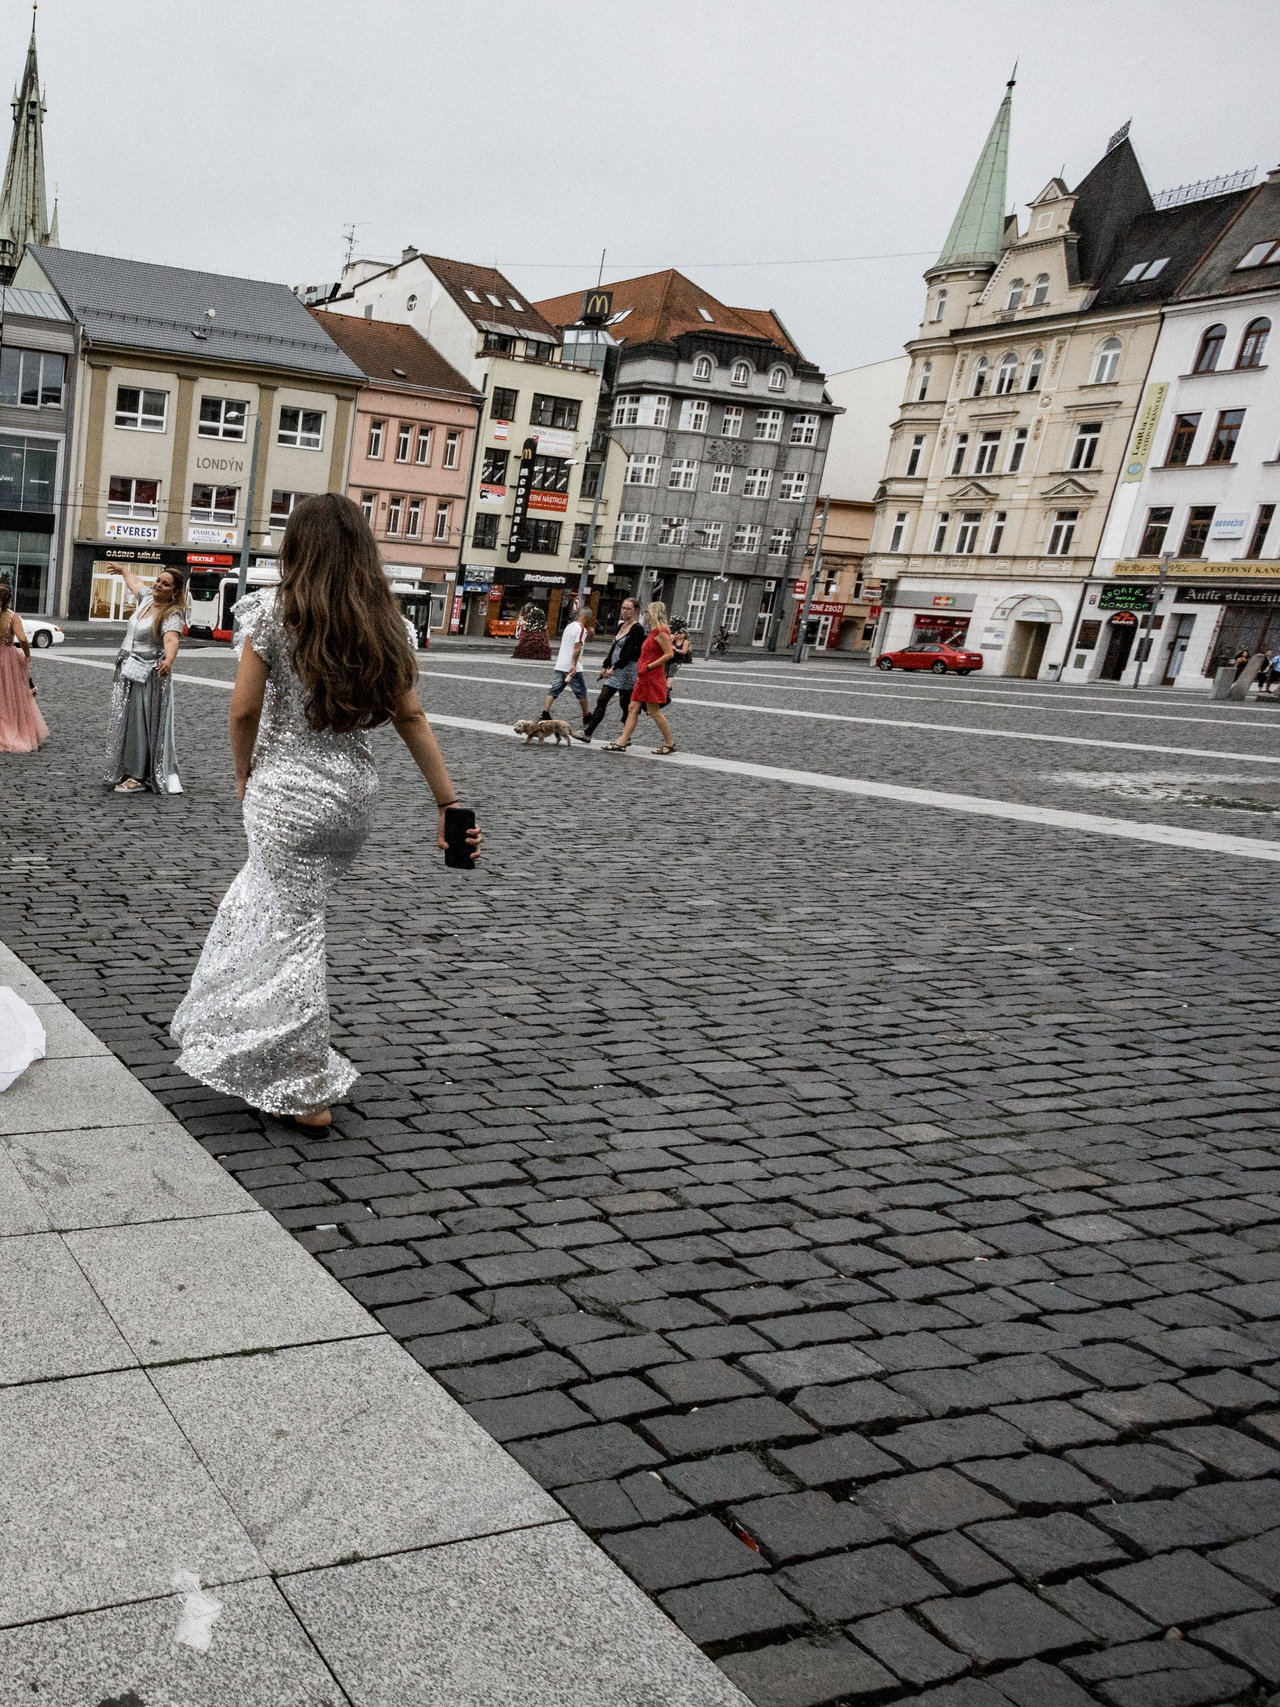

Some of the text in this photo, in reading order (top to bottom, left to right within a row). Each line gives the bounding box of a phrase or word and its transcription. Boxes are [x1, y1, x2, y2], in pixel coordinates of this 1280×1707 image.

[196, 456, 244, 472] LONDÝN
[542, 495, 568, 505] NÁSTROJE
[116, 525, 158, 538] EVEREST
[193, 529, 221, 537] INDICKÁ
[106, 550, 161, 560] CASINO MÍRÁK
[1203, 565, 1251, 573] CESTOVNÍ
[523, 573, 566, 584] McDonald's
[1184, 588, 1221, 600] Antic
[824, 604, 844, 613] ZBOŽÍ
